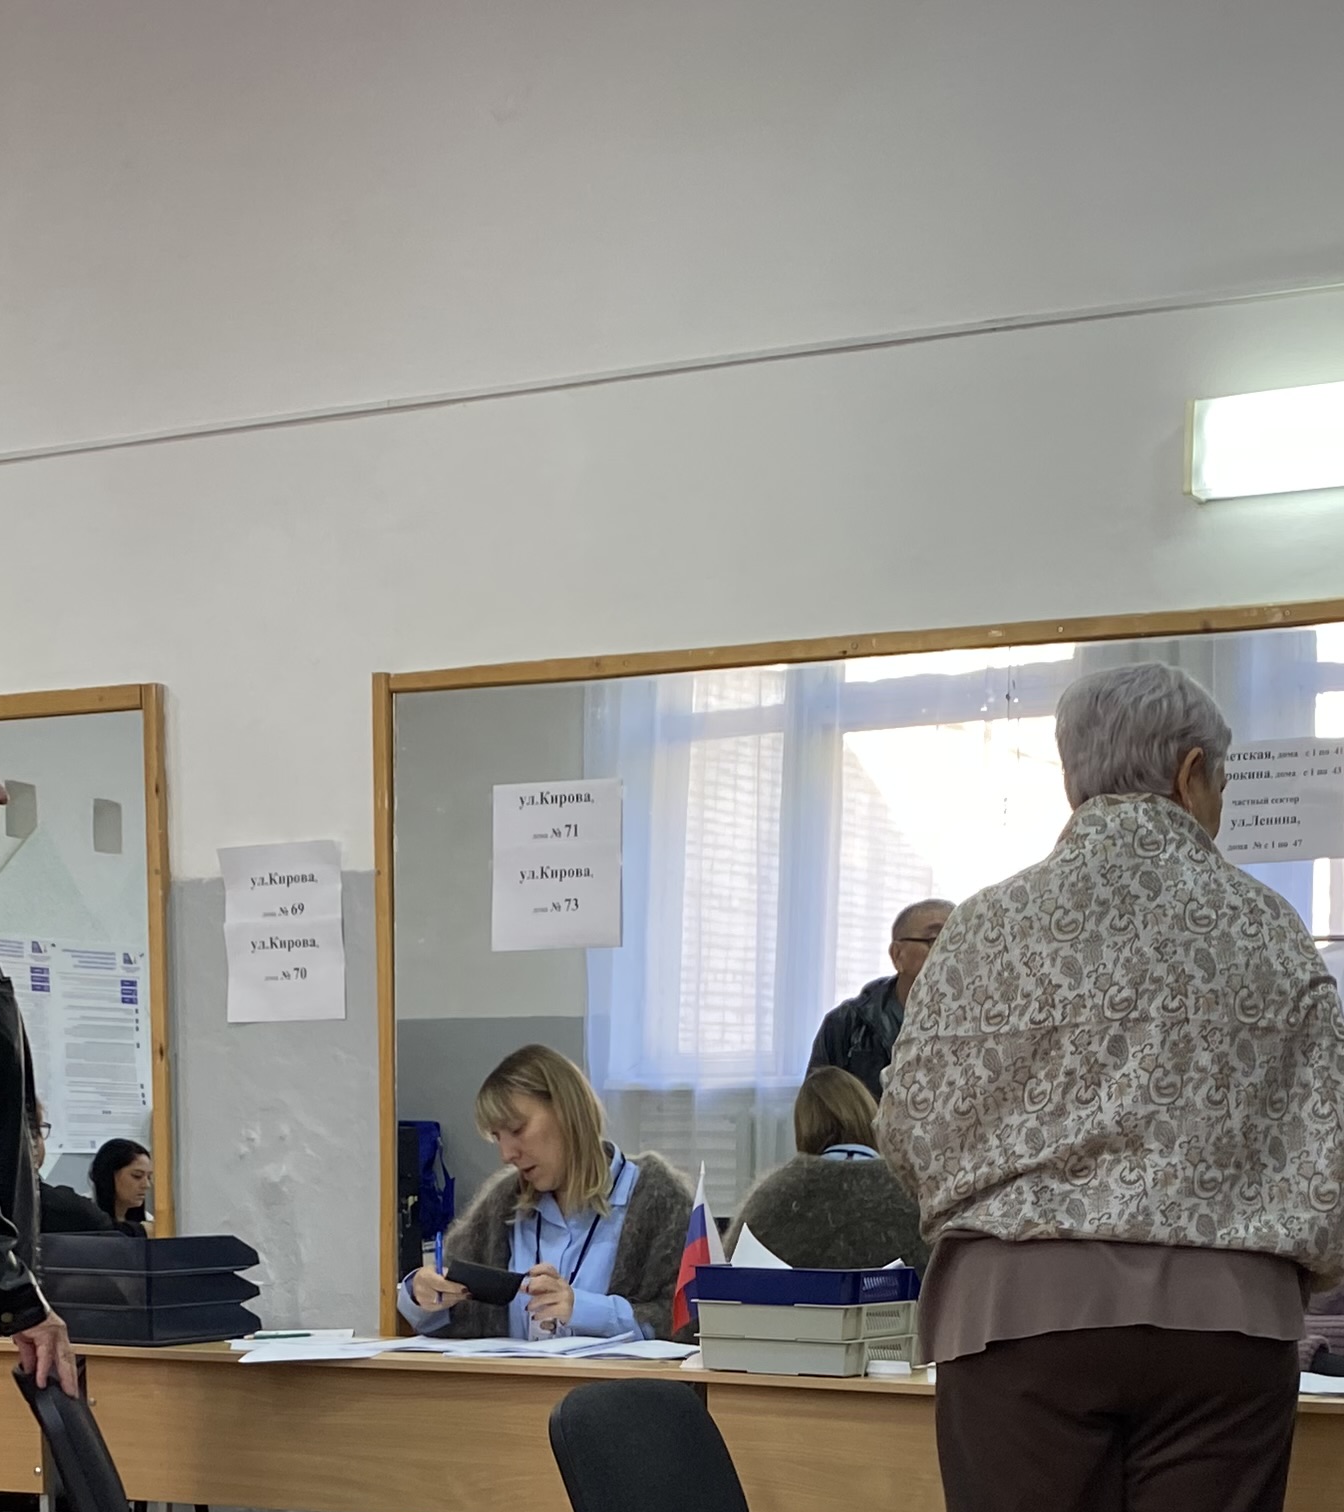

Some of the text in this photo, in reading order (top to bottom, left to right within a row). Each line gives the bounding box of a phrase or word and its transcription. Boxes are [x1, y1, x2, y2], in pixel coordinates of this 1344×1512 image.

[564, 824, 578, 837] 71
[291, 903, 305, 916] 69
[564, 898, 579, 912] 73
[293, 967, 307, 980] 70
